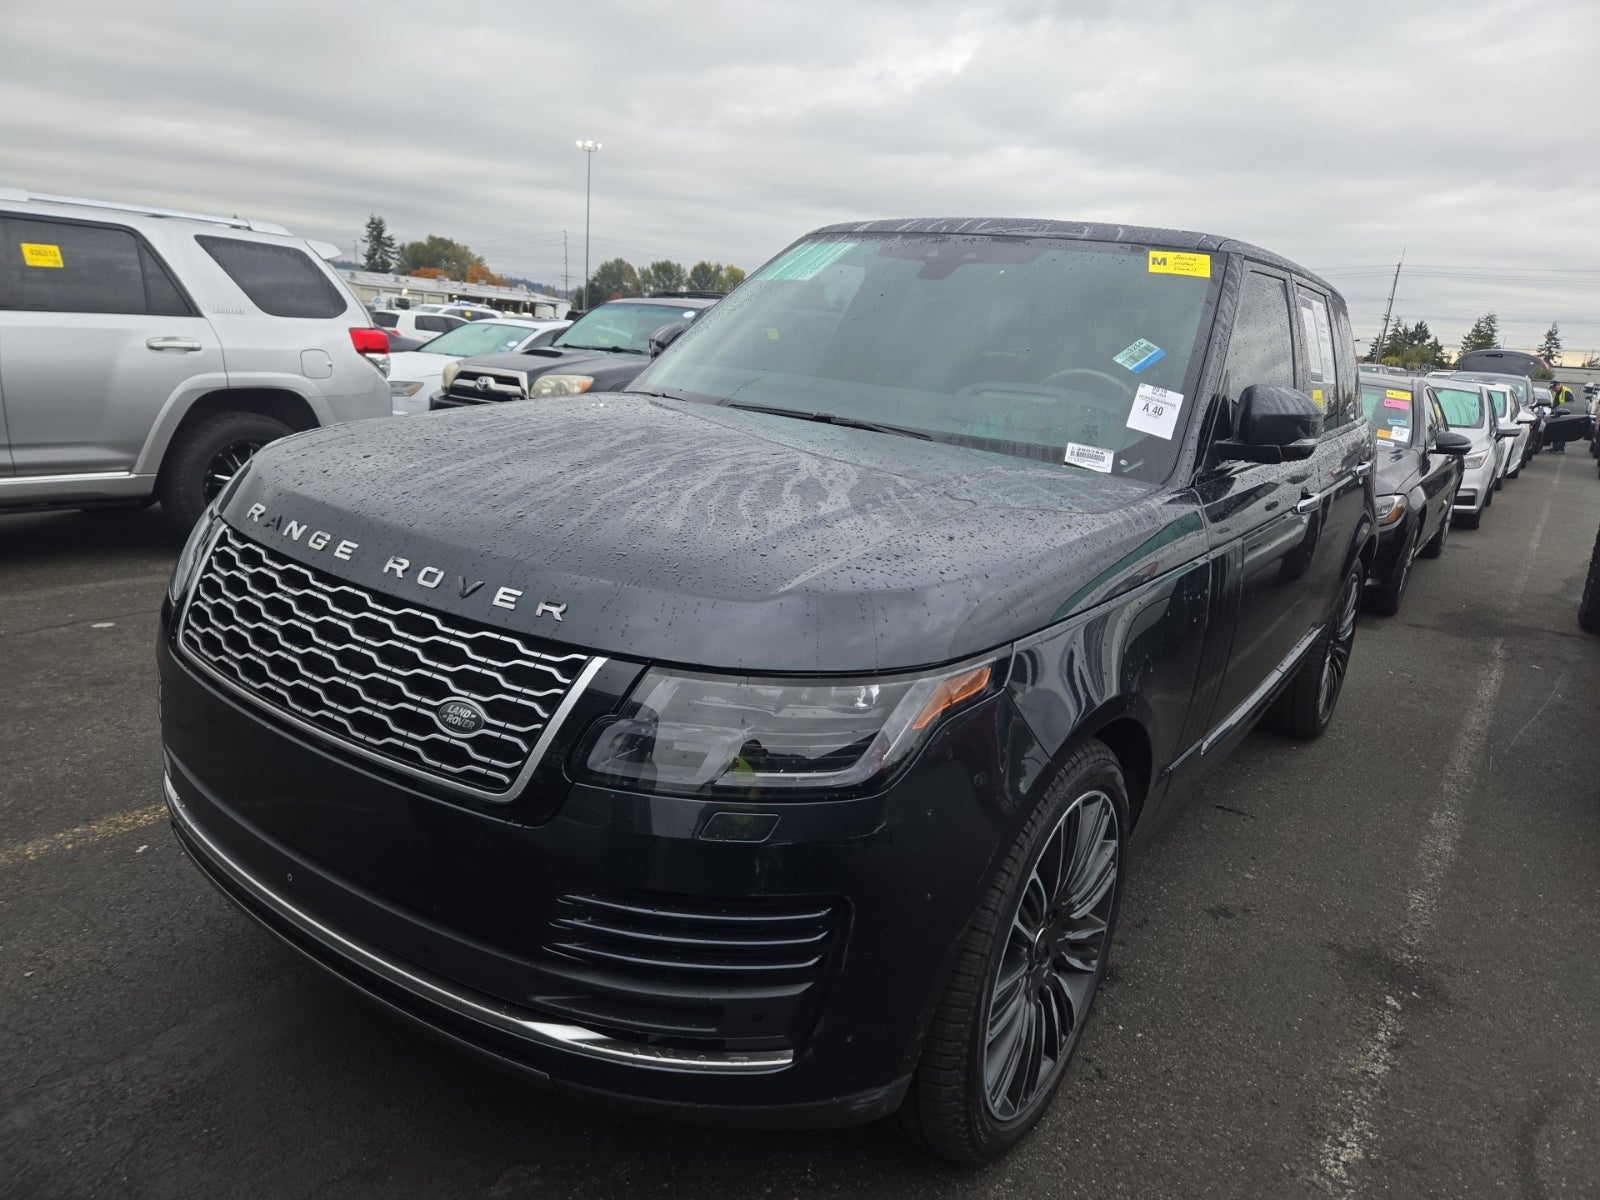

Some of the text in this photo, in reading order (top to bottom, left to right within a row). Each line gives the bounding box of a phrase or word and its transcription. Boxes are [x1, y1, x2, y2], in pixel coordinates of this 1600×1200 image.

[1151, 257, 1167, 266] M
[1142, 402, 1150, 413] A
[1152, 405, 1164, 417] 40
[246, 502, 568, 622] RANGE ROVER
[447, 704, 472, 718] LAND
[446, 714, 476, 729] ROVER
